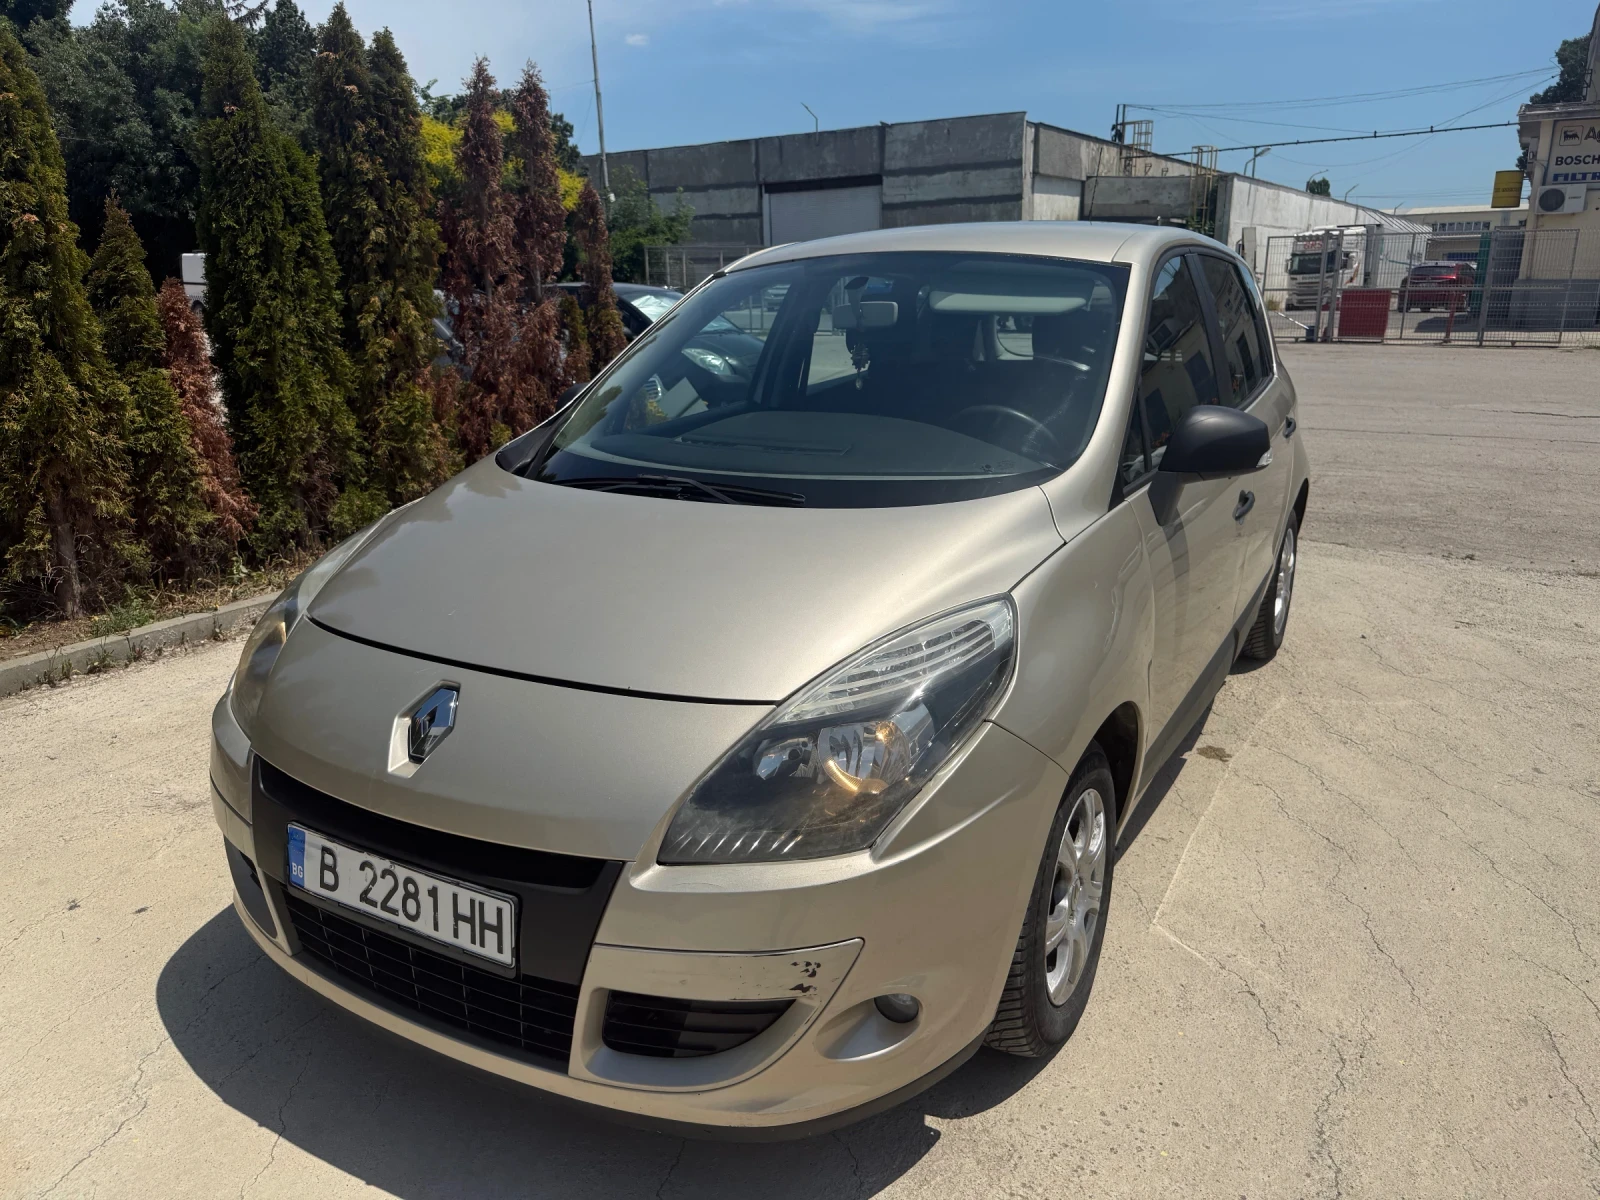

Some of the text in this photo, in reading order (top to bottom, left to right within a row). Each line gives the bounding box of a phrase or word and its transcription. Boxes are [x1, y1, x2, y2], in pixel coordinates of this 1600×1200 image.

[1555, 154, 1600, 166] BOSCH
[291, 862, 304, 878] BG
[319, 845, 339, 892] B
